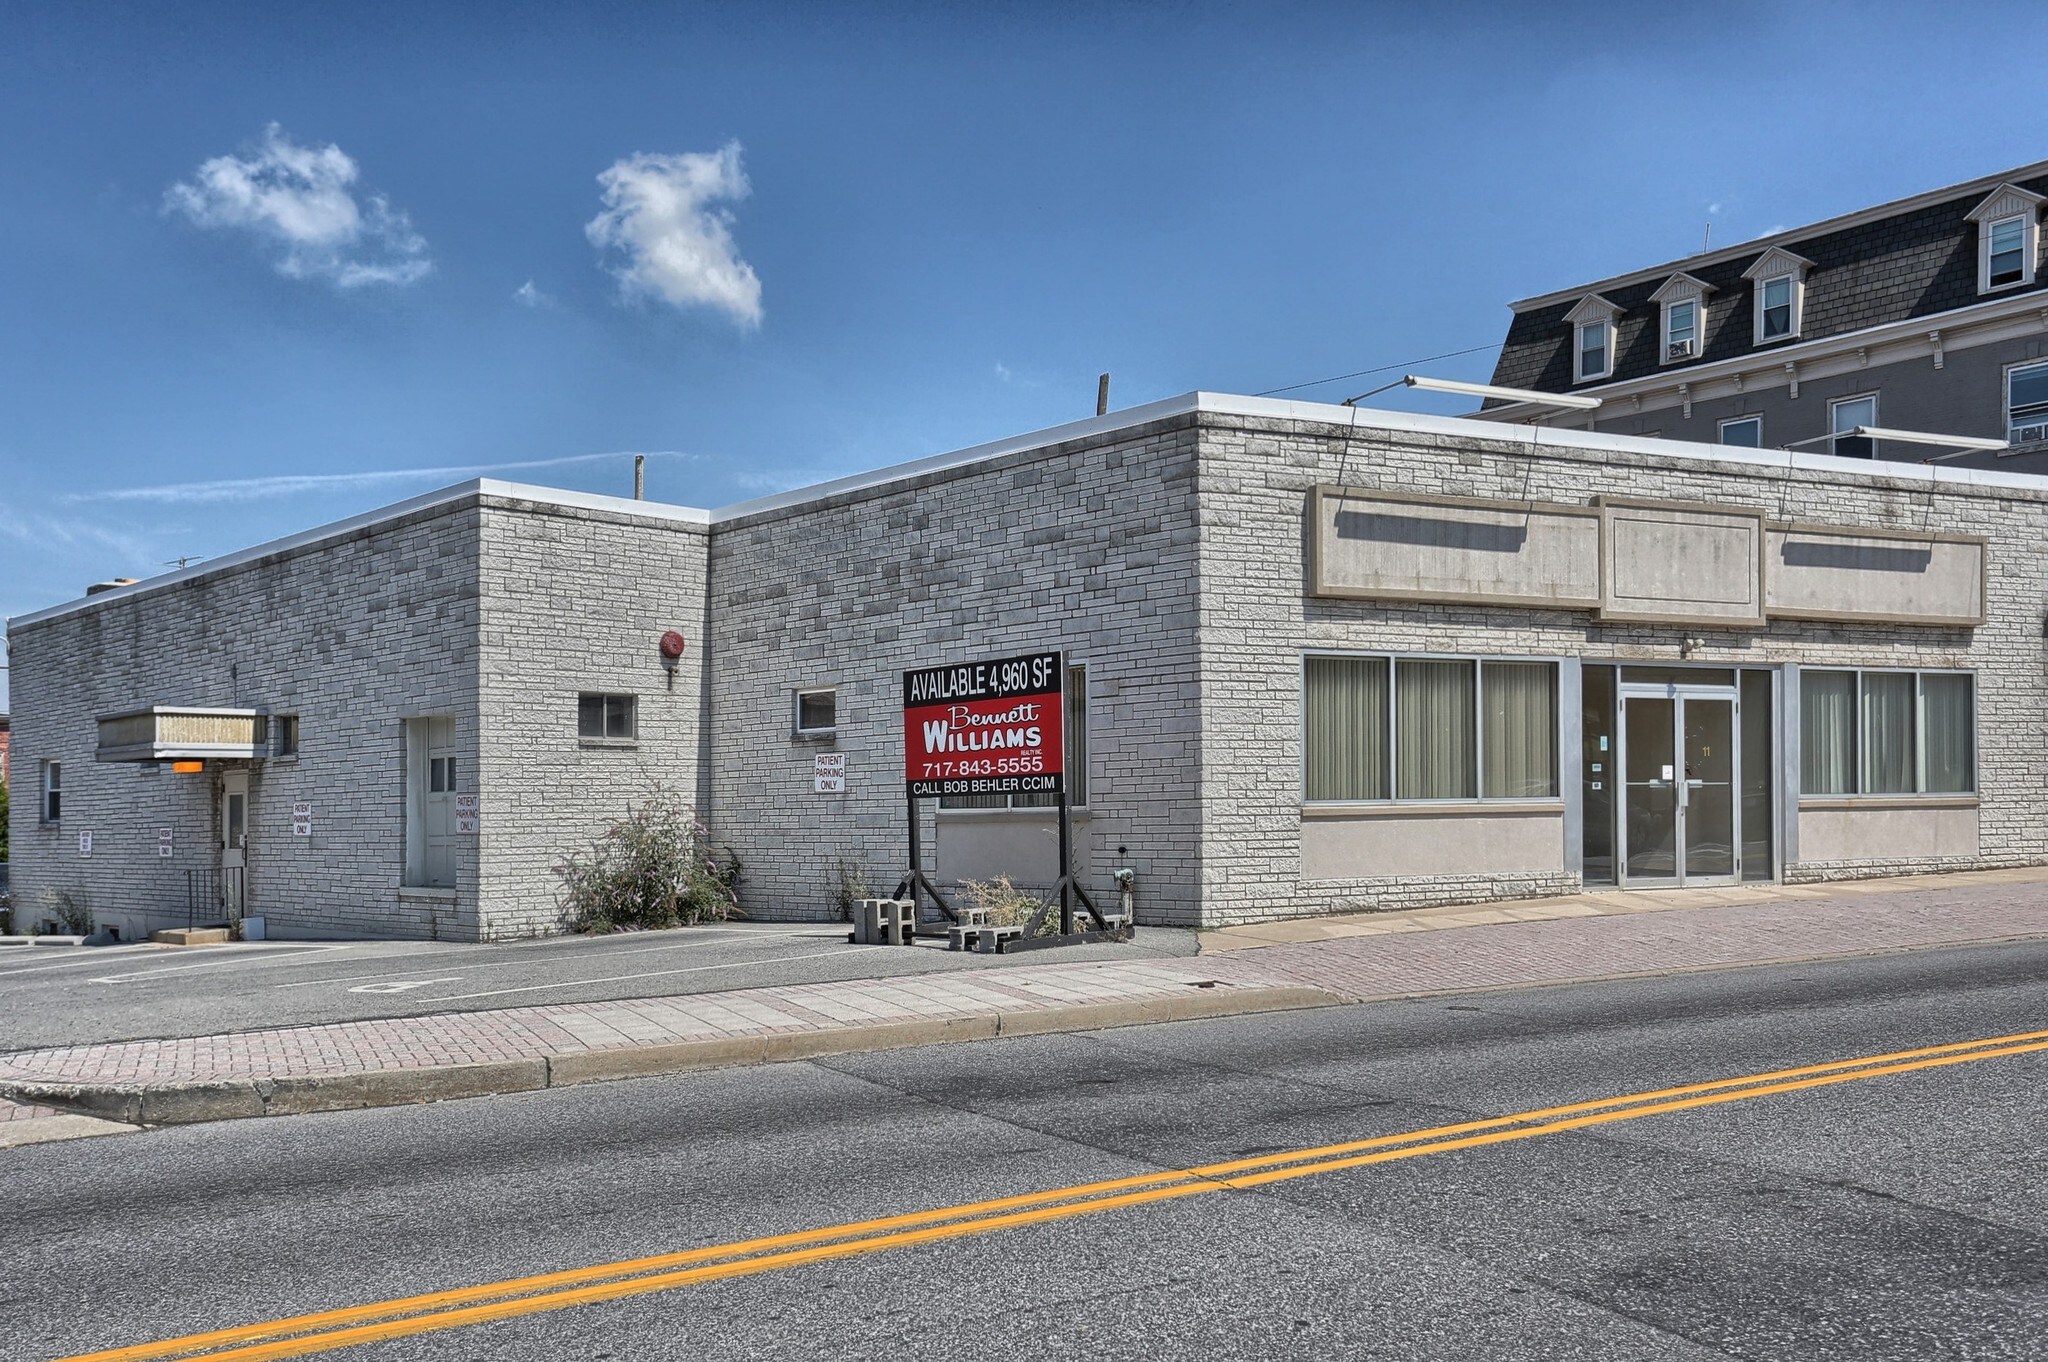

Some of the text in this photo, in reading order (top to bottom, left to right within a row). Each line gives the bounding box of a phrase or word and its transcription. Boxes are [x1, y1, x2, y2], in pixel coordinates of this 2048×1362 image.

[911, 657, 1053, 702] AVAILABLE 4,960 SF
[947, 703, 1042, 730] Bennett
[922, 719, 1042, 754] WILLIAMS
[1702, 745, 1711, 757] 11
[817, 755, 843, 766] PATIENT
[922, 756, 1043, 777] 717-843-5555
[816, 767, 844, 778] PARKING
[821, 780, 838, 790] ONLY
[913, 776, 1055, 795] CALL BOB BEHLER CCIM
[457, 796, 478, 806] PATIENT
[456, 808, 478, 819] PARKING
[461, 821, 474, 831] ONLY
